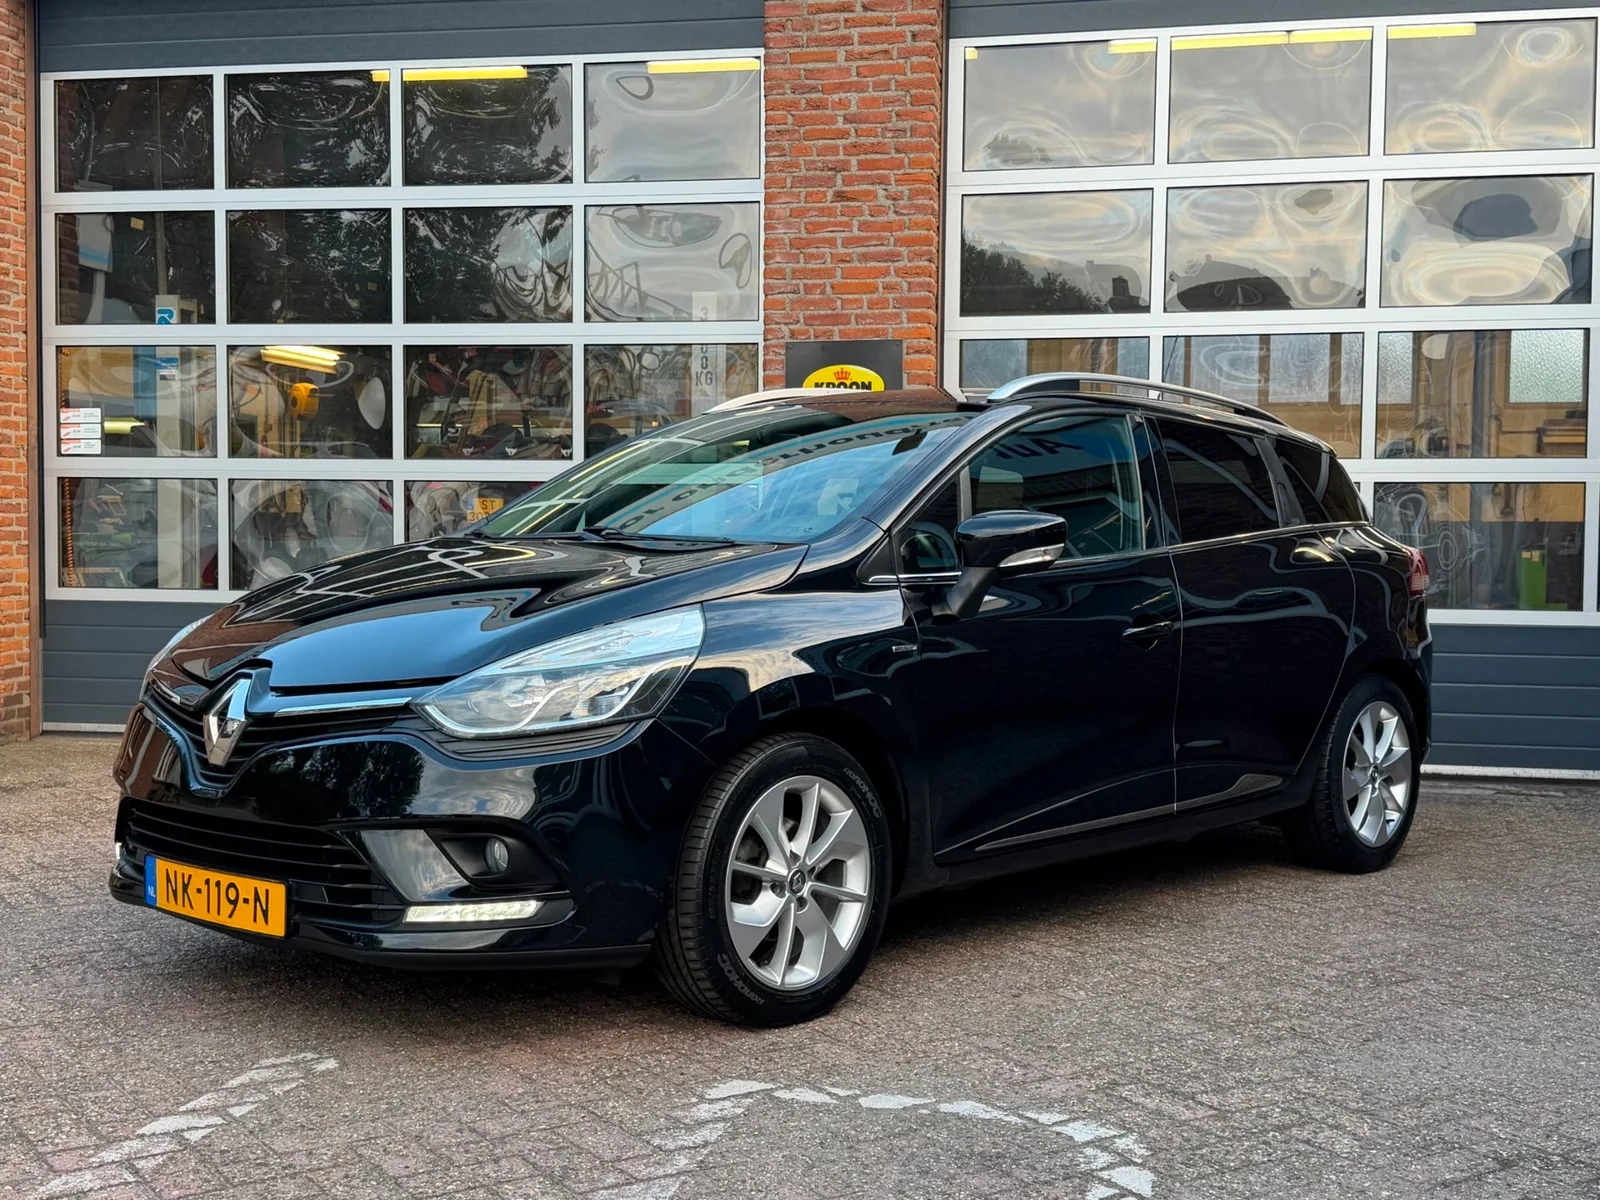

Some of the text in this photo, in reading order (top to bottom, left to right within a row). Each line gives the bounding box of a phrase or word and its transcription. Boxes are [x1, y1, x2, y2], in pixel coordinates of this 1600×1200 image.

[695, 370, 714, 386] KG
[481, 499, 496, 510] ST
[147, 885, 156, 898] NL
[165, 867, 270, 926] NK-119-N
